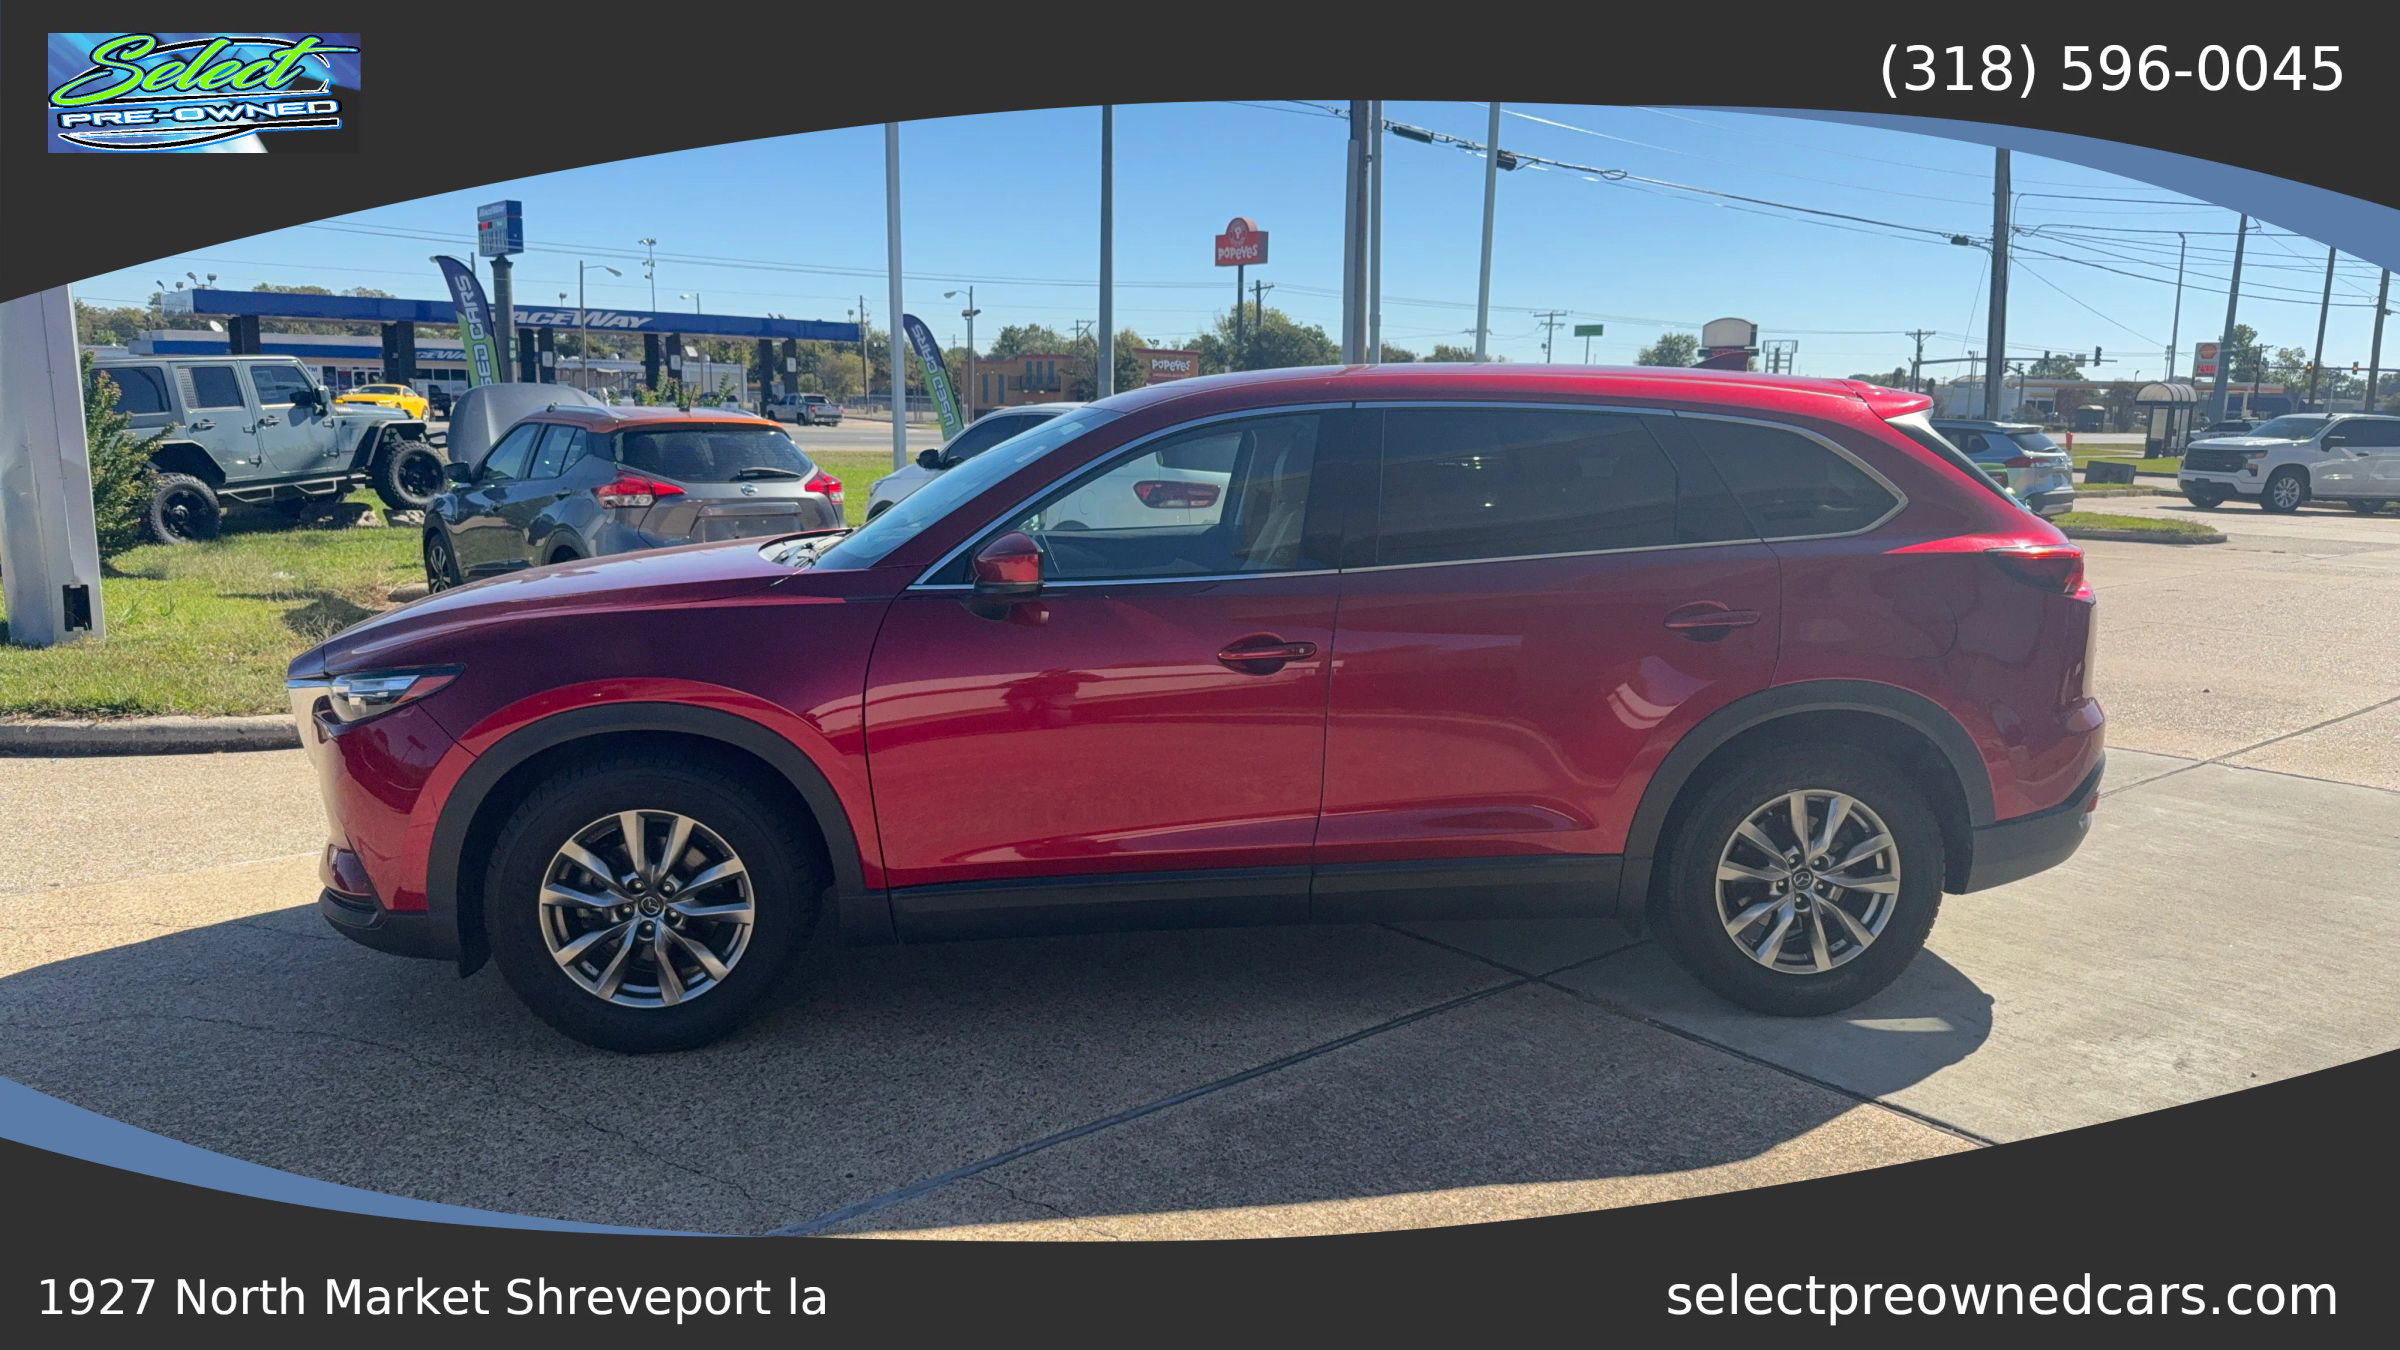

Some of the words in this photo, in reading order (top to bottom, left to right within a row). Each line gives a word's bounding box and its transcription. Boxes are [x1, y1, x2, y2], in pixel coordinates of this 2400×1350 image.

[455, 275, 485, 341] CARS
[911, 325, 938, 374] CARS
[932, 376, 955, 426] USED
